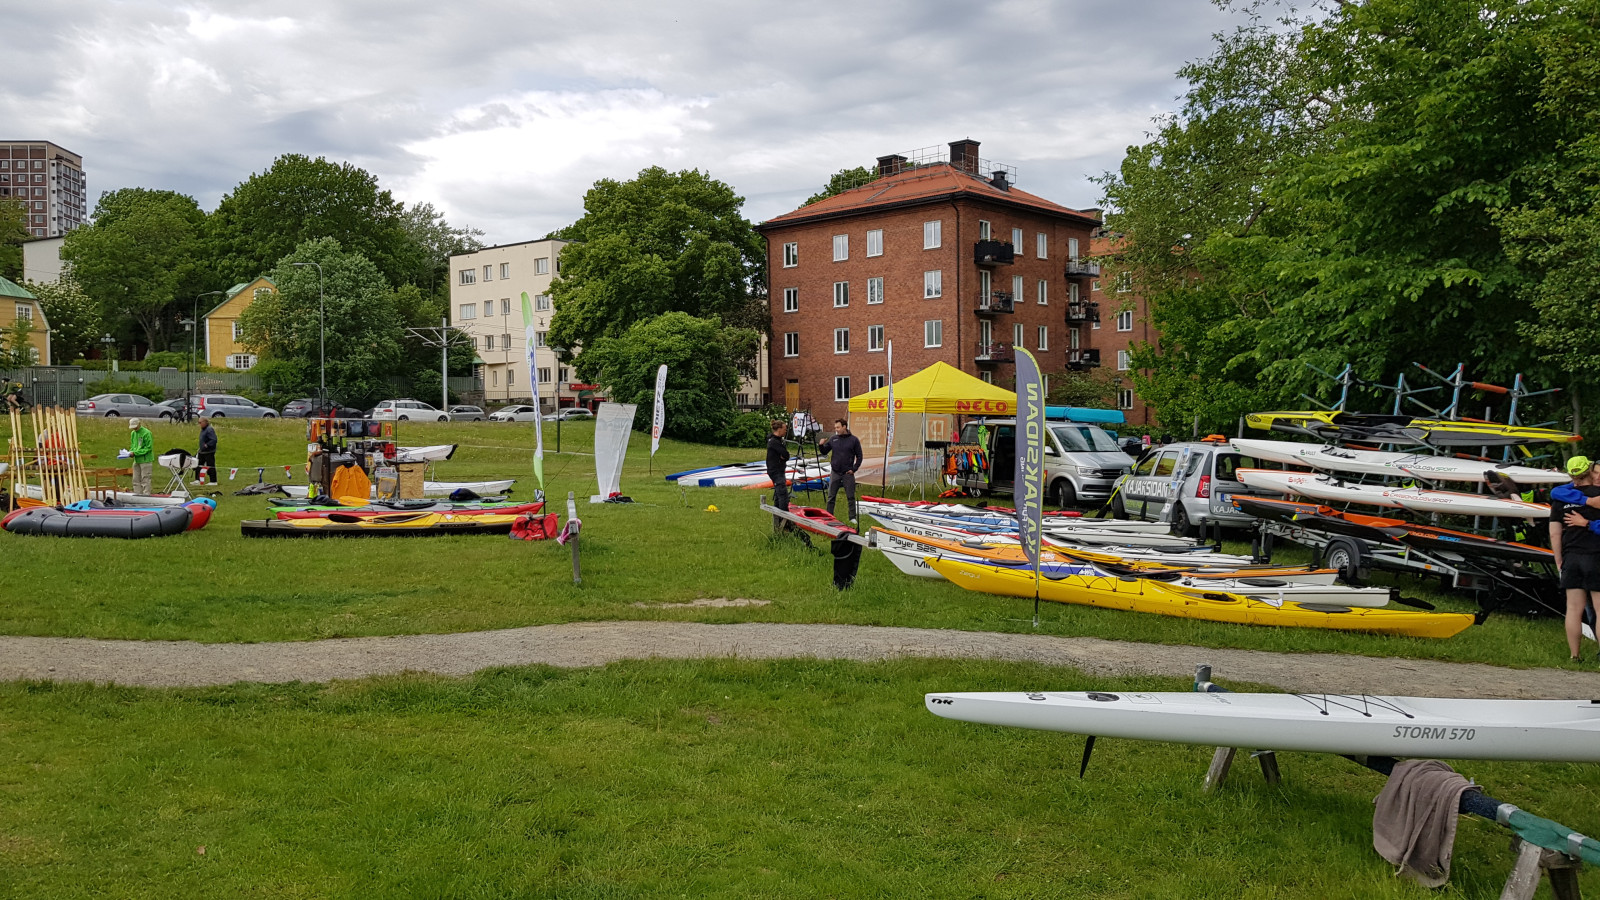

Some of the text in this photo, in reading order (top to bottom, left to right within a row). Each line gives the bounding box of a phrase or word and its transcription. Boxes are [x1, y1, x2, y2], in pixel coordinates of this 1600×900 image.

[868, 399, 903, 410] NEO
[956, 400, 1008, 412] NELO
[1124, 479, 1168, 498] KAJAKSIDAN
[904, 526, 923, 536] Mira
[889, 535, 914, 549] Player
[1393, 725, 1476, 741] STORM 570
